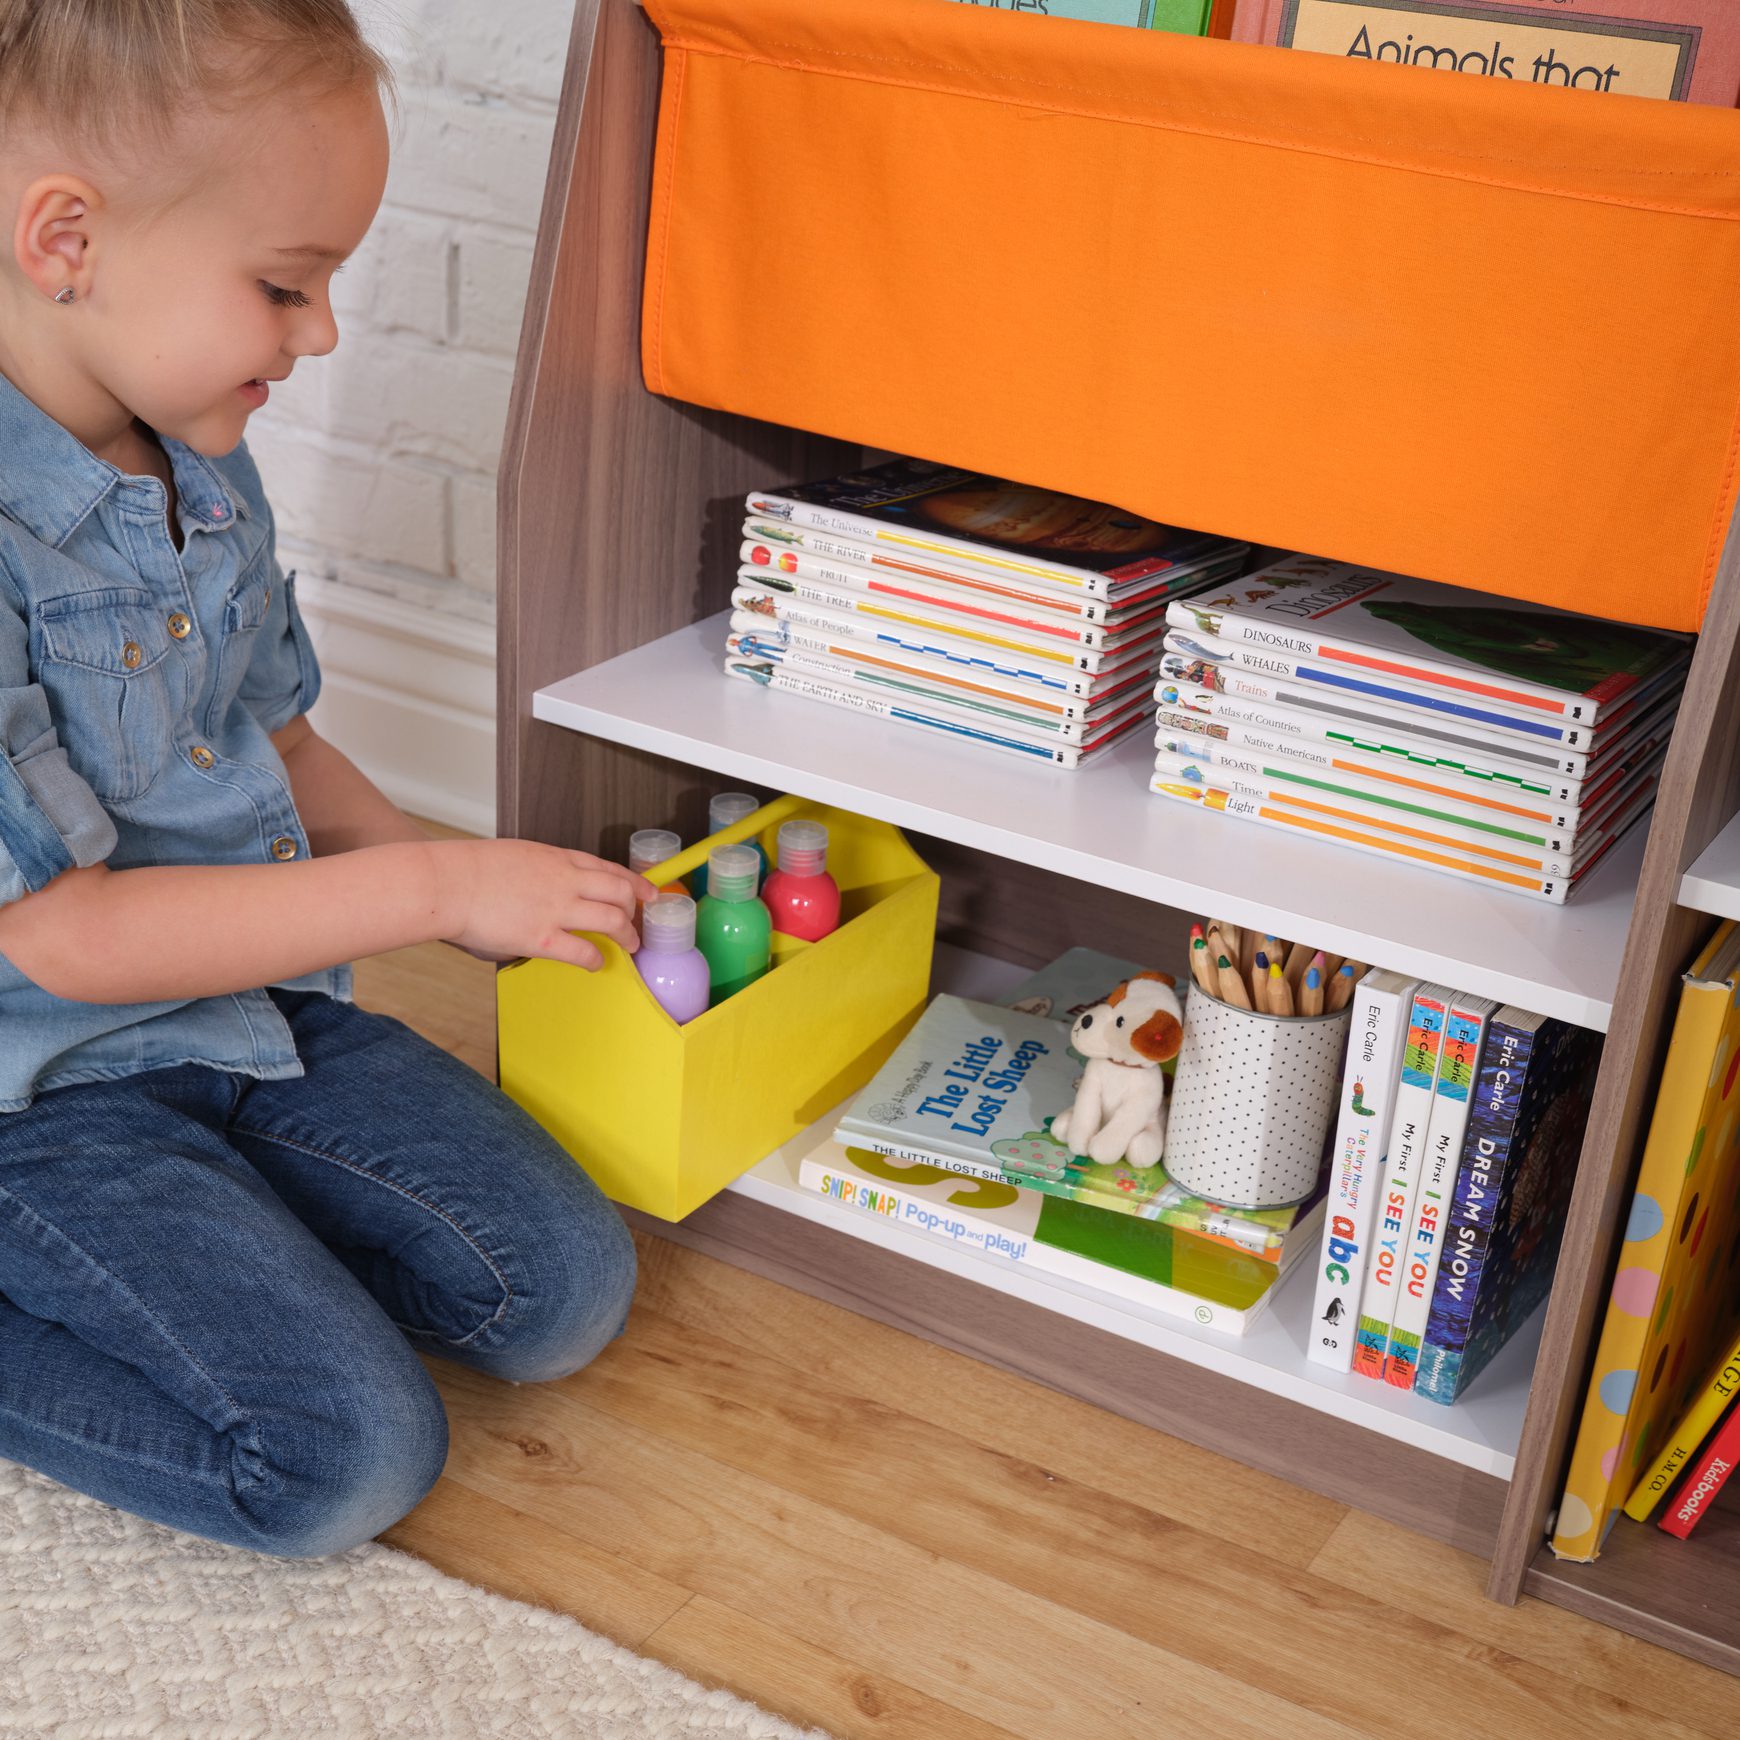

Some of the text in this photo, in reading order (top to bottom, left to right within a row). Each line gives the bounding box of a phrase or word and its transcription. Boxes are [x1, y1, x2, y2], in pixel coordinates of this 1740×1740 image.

[810, 513, 873, 537] The Universe
[813, 539, 834, 553] THE
[800, 586, 852, 609] THE TREE
[1265, 573, 1383, 617] Dinosaurs
[786, 611, 854, 635] Atlas of People
[793, 636, 827, 652] WATER
[1243, 627, 1312, 654] DINOSAURS
[1242, 653, 1290, 675] WHALES
[1234, 679, 1268, 698] Trains
[1217, 705, 1302, 734] Atlas of Countries
[1220, 756, 1258, 774] BOATS
[1243, 734, 1327, 764] Native Americans
[1228, 797, 1255, 815] Light
[1232, 780, 1263, 798] Time
[1363, 1005, 1381, 1062] Eric Carle
[1415, 1017, 1433, 1071] Eric Carle
[1451, 1029, 1470, 1083] Eric Carle
[916, 1035, 1003, 1122] The Little
[950, 1038, 1049, 1137] Lost Sheep
[1490, 1036, 1519, 1112] Eric Carle
[872, 1144, 1023, 1187] THE LITTLE LOST SHEEP
[1339, 1137, 1356, 1198] Caterpillar's
[1348, 1128, 1370, 1210] The Very Hungry
[1398, 1123, 1416, 1172] My First
[1432, 1135, 1451, 1184] My First
[820, 1174, 857, 1203] SNIP!
[858, 1187, 902, 1219] SNAP!
[905, 1202, 966, 1239] Pop-up
[966, 1228, 984, 1242] and
[984, 1233, 1027, 1259] play!
[1375, 1178, 1408, 1287] I SEE YOU
[1446, 1136, 1496, 1301] DREAM SNOW
[1325, 1215, 1360, 1286] abc
[1407, 1190, 1441, 1299] I SEE YOU
[1427, 1349, 1446, 1393] Philomel
[1648, 1447, 1687, 1492] H. M. CO.
[1677, 1457, 1731, 1522] Kidsbooks
